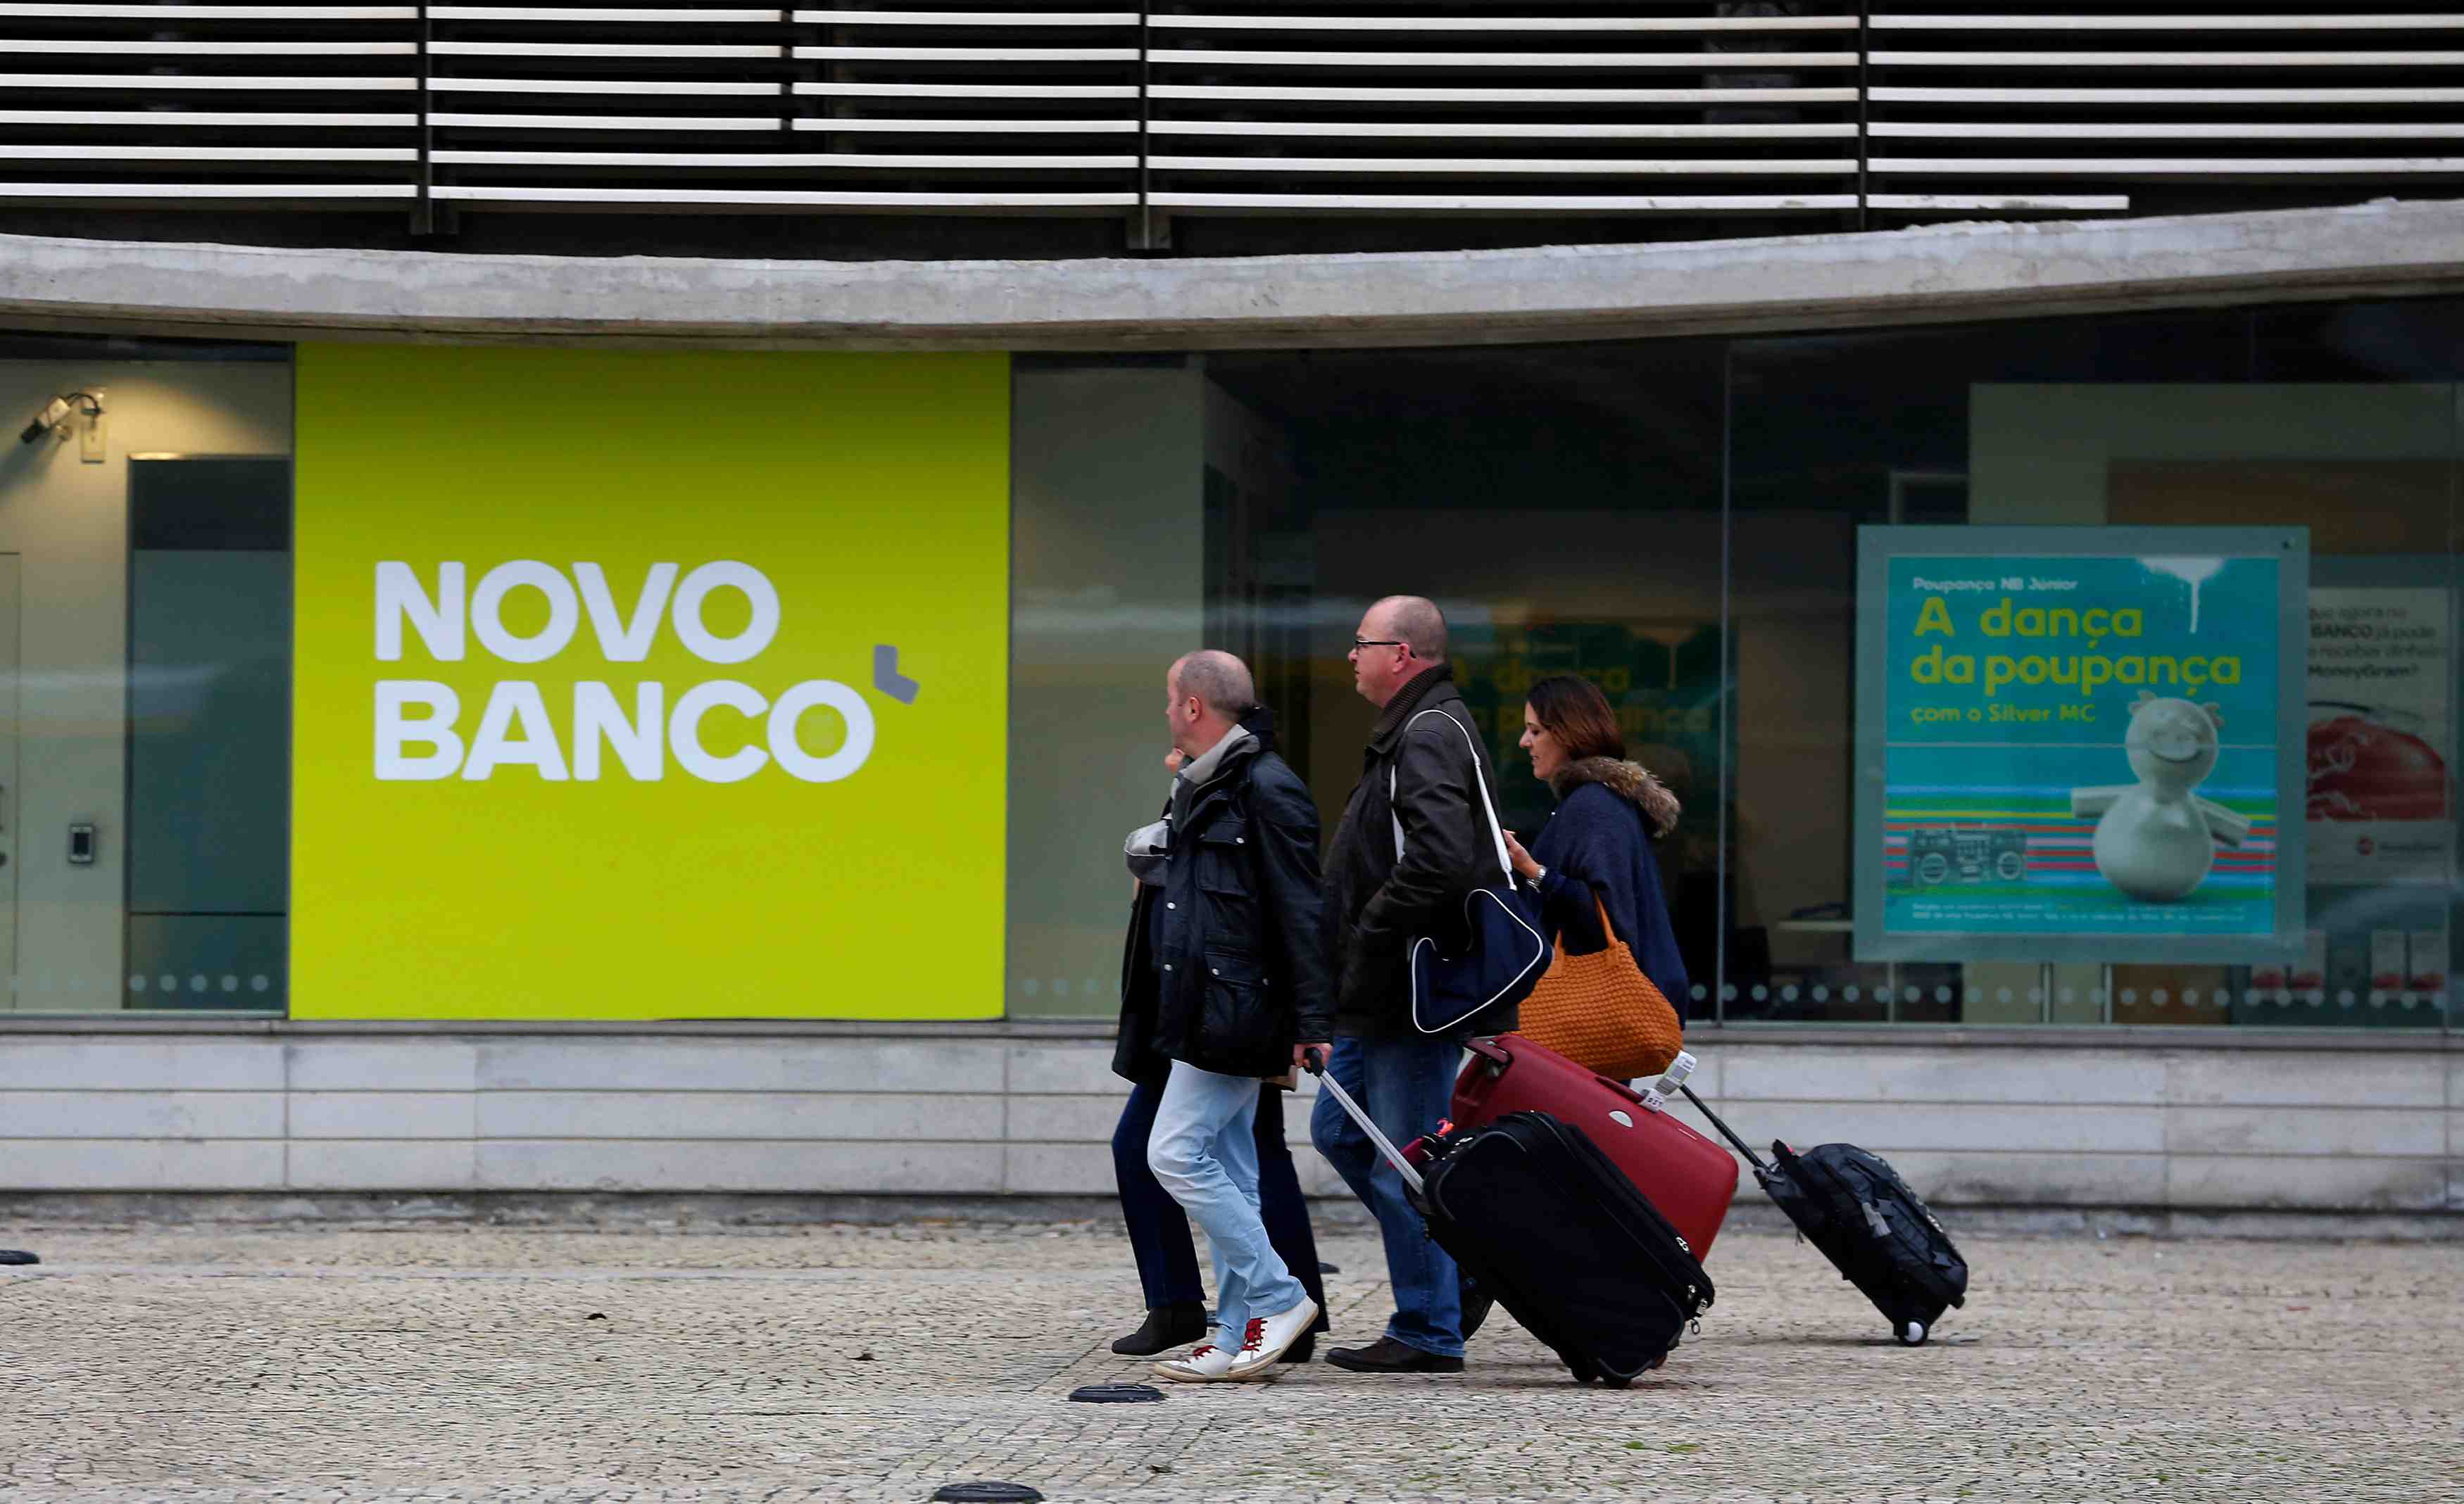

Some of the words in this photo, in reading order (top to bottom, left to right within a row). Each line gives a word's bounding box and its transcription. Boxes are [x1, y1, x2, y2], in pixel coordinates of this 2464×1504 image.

[375, 560, 781, 664] NOVO
[1913, 577, 1995, 594] Poupança
[2000, 577, 2024, 590] NB
[1913, 596, 1956, 637] A
[1980, 596, 2144, 649] dança
[2311, 623, 2373, 638] BANCO
[1911, 643, 1976, 684] da
[1984, 655, 2242, 697] poupança
[374, 679, 875, 783] BANCO
[1966, 708, 1982, 721] o
[1988, 703, 2051, 721] Silver
[2059, 704, 2096, 721] MC
